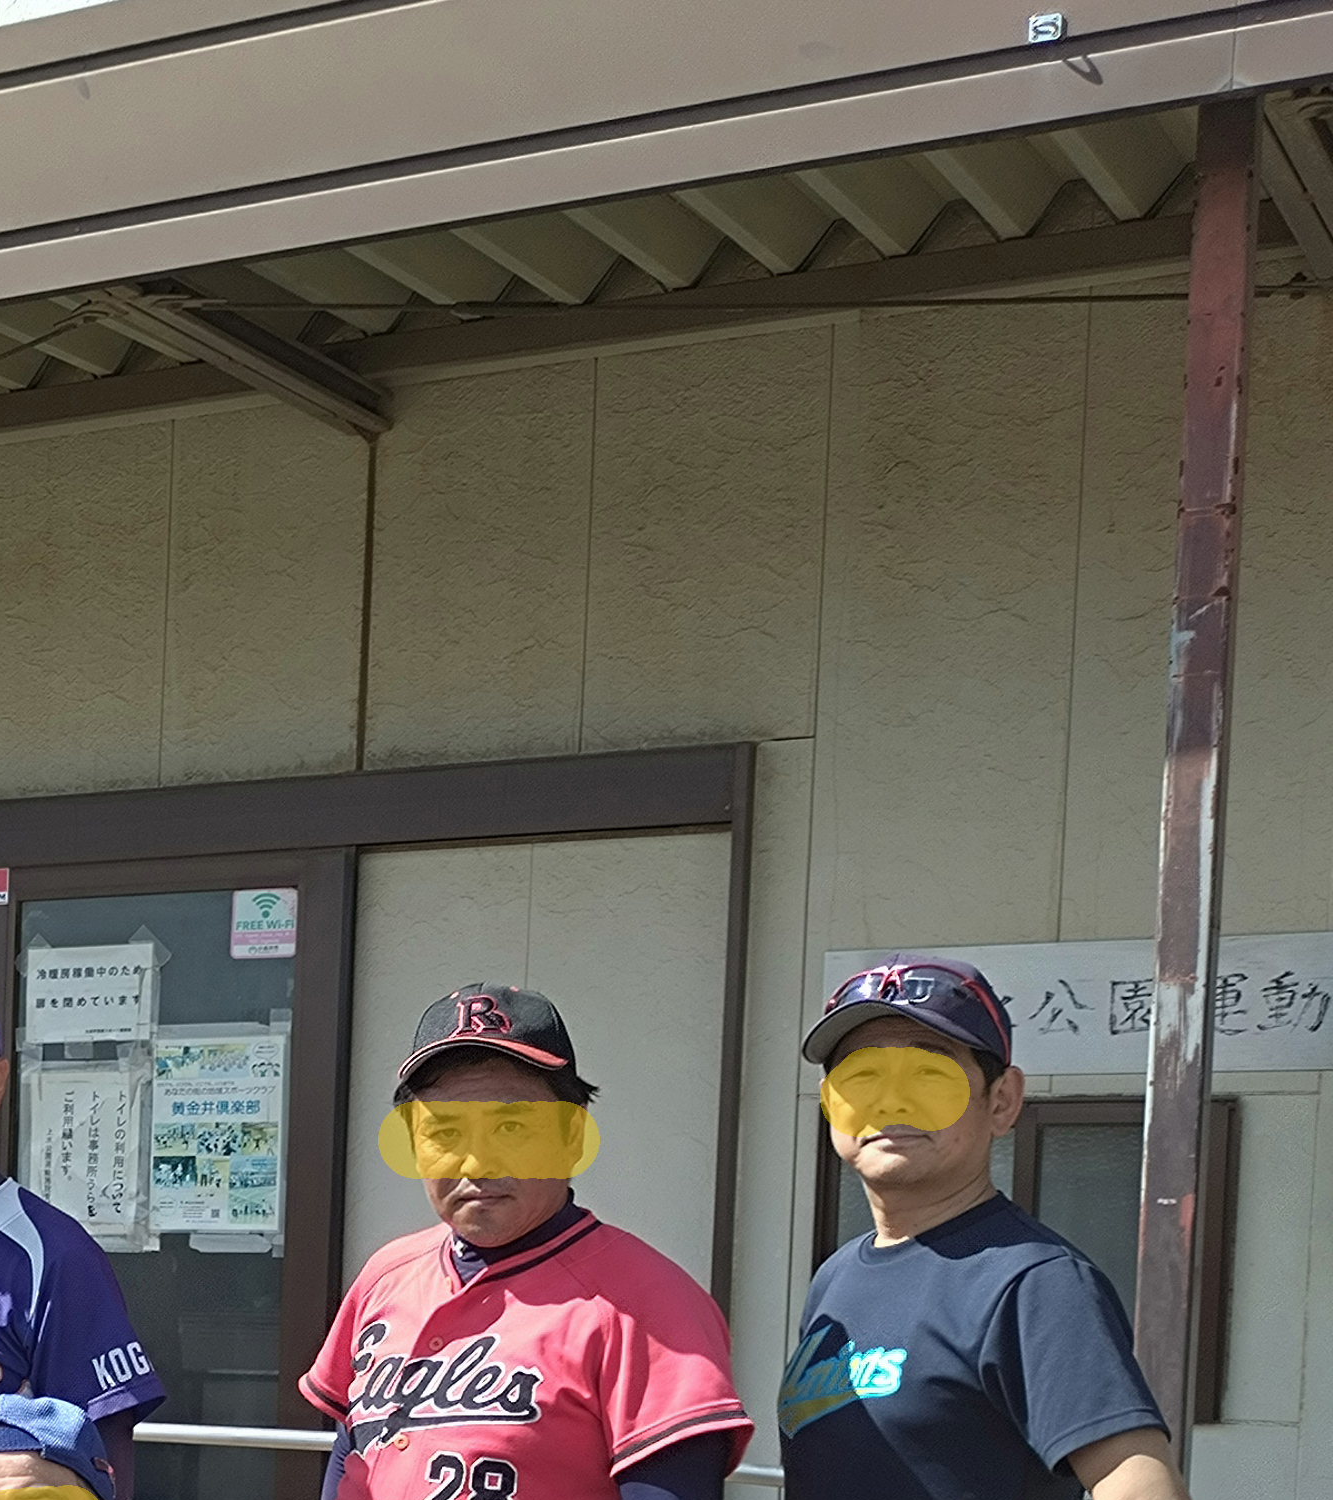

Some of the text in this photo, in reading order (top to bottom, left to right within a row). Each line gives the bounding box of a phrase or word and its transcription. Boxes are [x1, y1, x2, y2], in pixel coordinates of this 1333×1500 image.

[235, 919, 295, 931] FREE Wi-Fi
[171, 1100, 261, 1116] 黄金井倶楽部
[111, 1090, 128, 1214] トイレの利用について
[91, 1341, 155, 1391] KOG
[348, 1320, 544, 1425] Eagles
